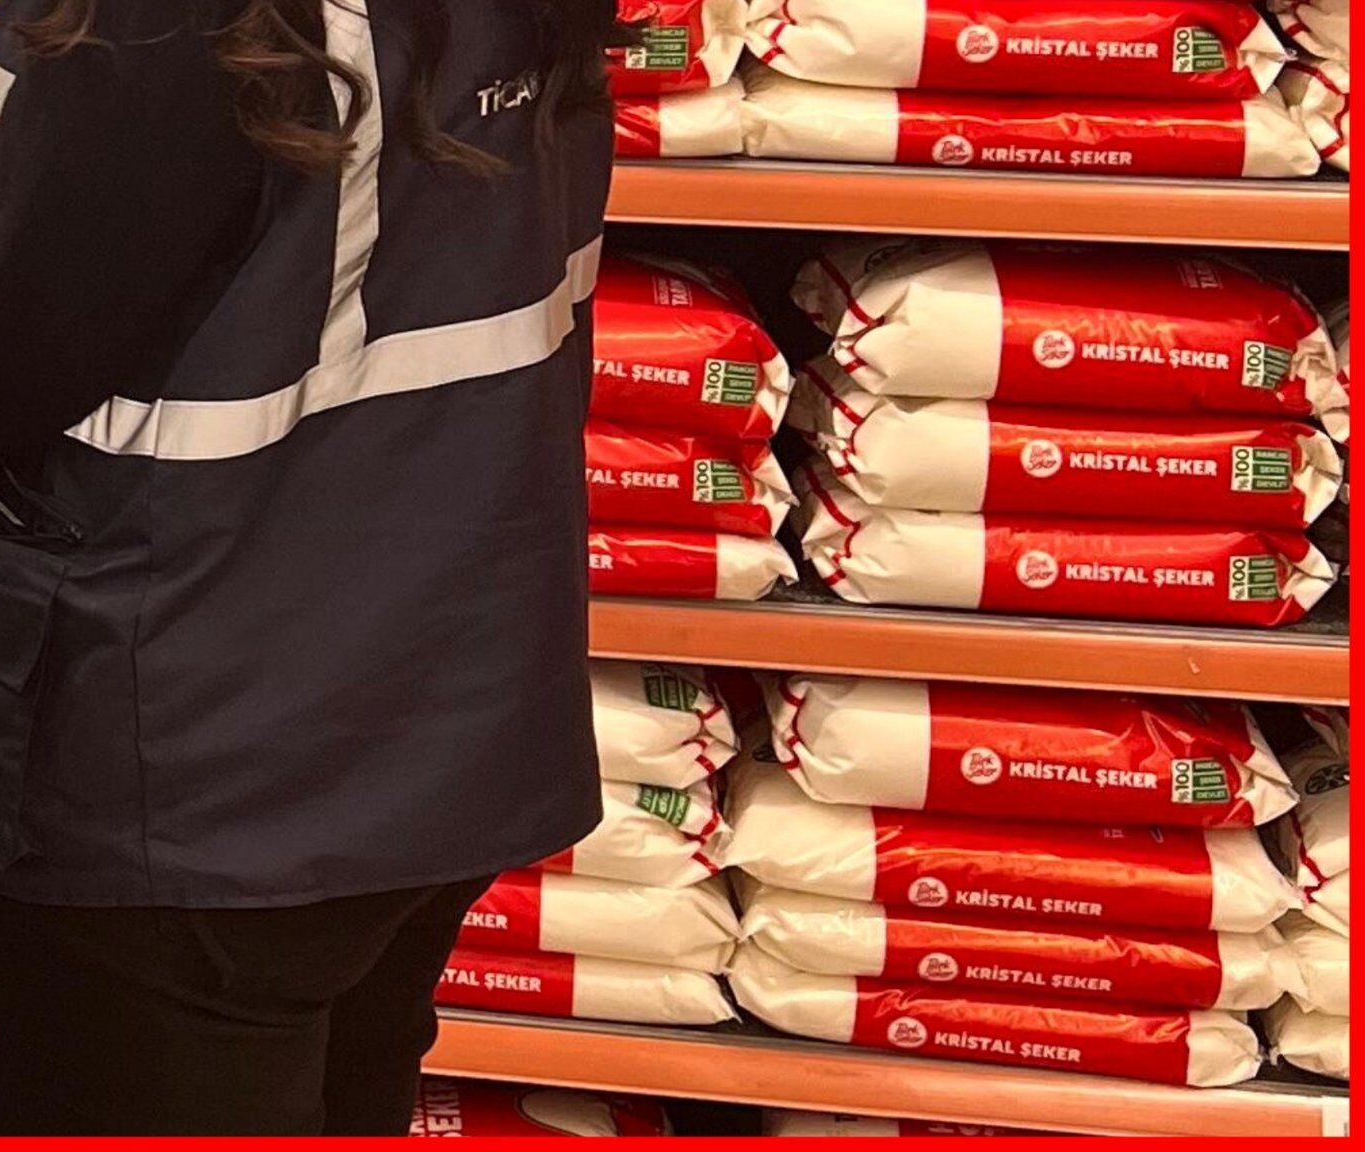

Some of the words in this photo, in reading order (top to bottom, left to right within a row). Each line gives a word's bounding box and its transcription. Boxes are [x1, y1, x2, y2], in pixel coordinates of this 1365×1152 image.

[1006, 38, 1091, 58] KRİSTAL
[1096, 41, 1159, 61] ŞEKER
[981, 145, 1065, 164] KRİSTAL
[1070, 149, 1132, 168] ŞEKER
[1082, 342, 1165, 364] KRİSTAL
[1168, 349, 1229, 370] ŞEKER
[631, 365, 690, 386] ŞEKER
[1069, 451, 1152, 473] KRİSTAL
[1155, 458, 1217, 478] ŞEKER
[621, 471, 680, 489] ŞEKER
[1065, 562, 1149, 585] KRİSTAL
[1153, 567, 1215, 588] ŞEKER
[1009, 760, 1091, 784] KRİSTAL
[1095, 769, 1158, 789] ŞEKER
[955, 888, 1037, 912] KRİSTAL
[1041, 897, 1103, 917] ŞEKER
[484, 972, 542, 992] ŞEKER
[965, 964, 1047, 987] KRİSTAL
[1051, 973, 1113, 992] ŞEKER
[934, 1031, 1015, 1056] KRİSTAL
[1019, 1042, 1082, 1062] ŞEKER
